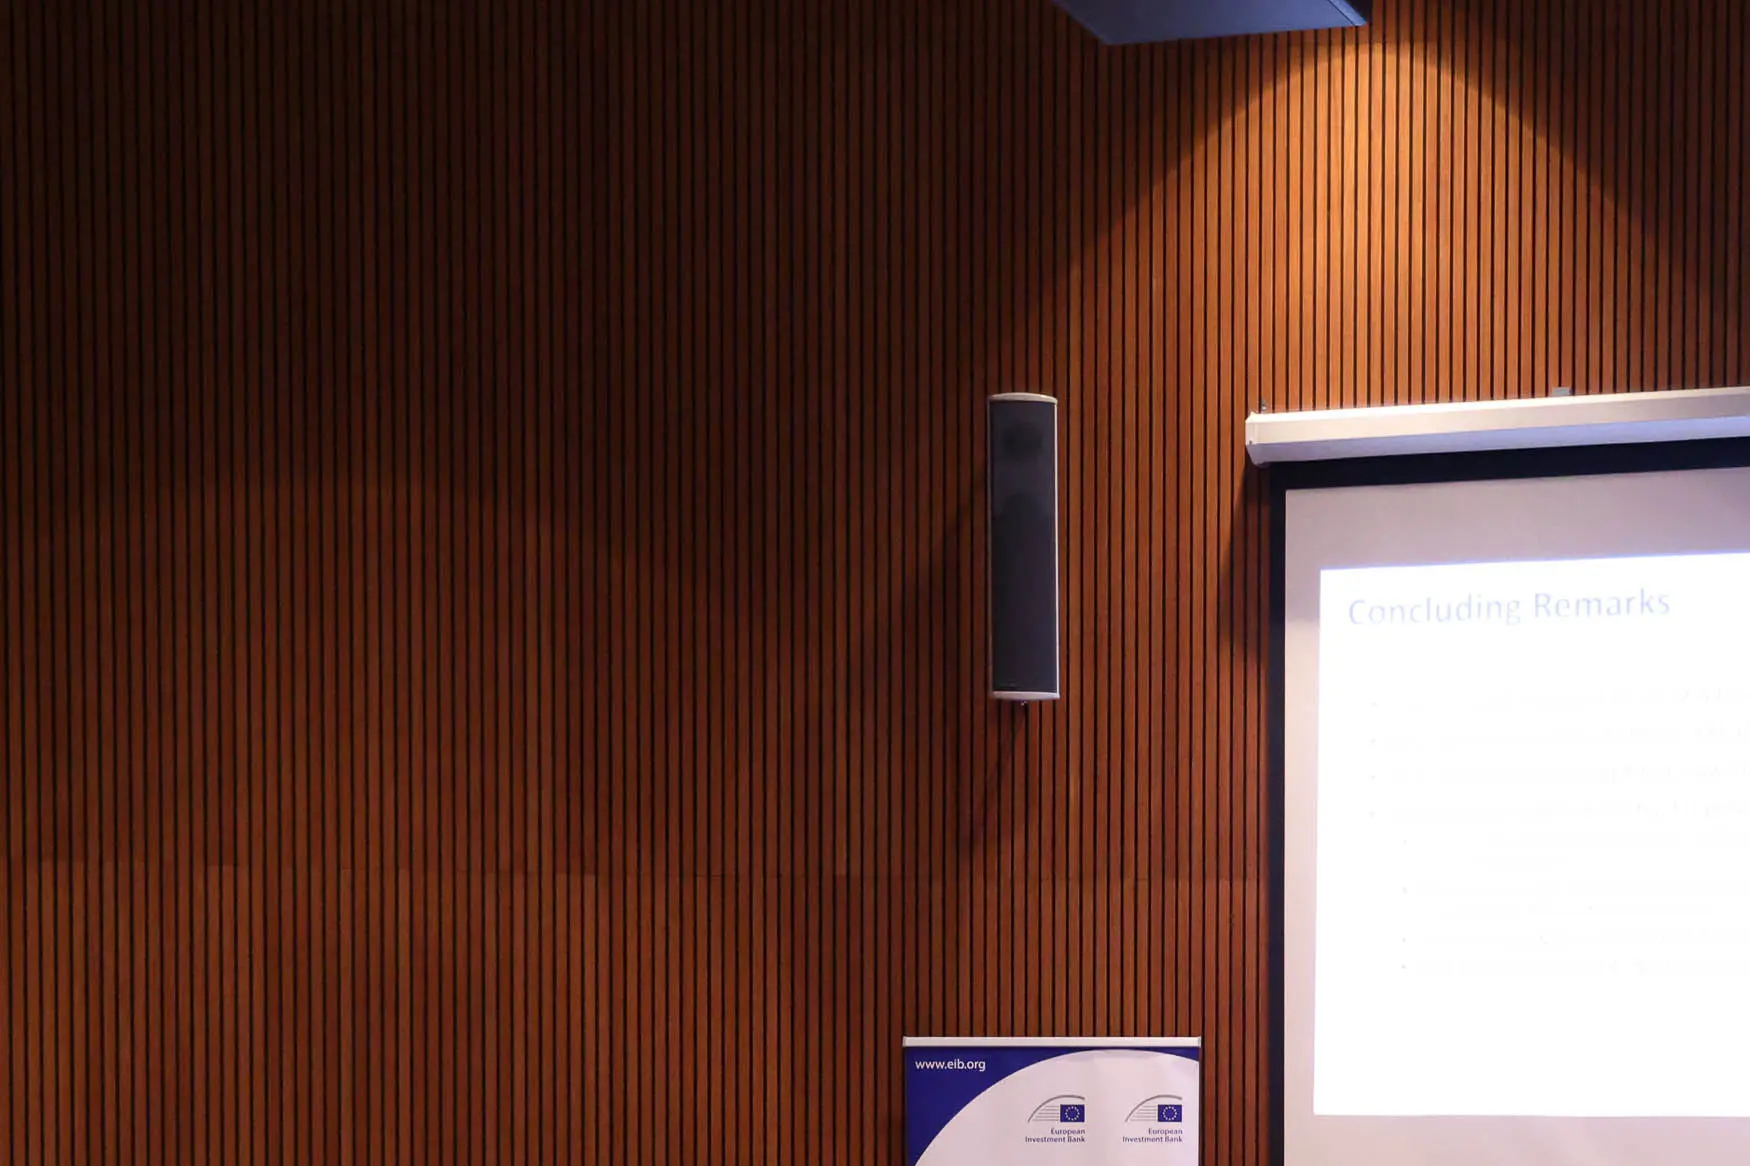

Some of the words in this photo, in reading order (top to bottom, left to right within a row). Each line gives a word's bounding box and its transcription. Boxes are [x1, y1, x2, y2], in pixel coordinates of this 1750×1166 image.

[1348, 593, 1521, 626] Concluding
[1534, 587, 1671, 619] Remarks
[915, 1058, 986, 1072] www.eib.org
[1051, 1127, 1085, 1137] European
[1148, 1127, 1182, 1137] European
[1025, 1135, 1066, 1143] Investment
[1067, 1135, 1085, 1143] Bank
[1123, 1135, 1163, 1143] Investment
[1164, 1135, 1182, 1143] Bank
